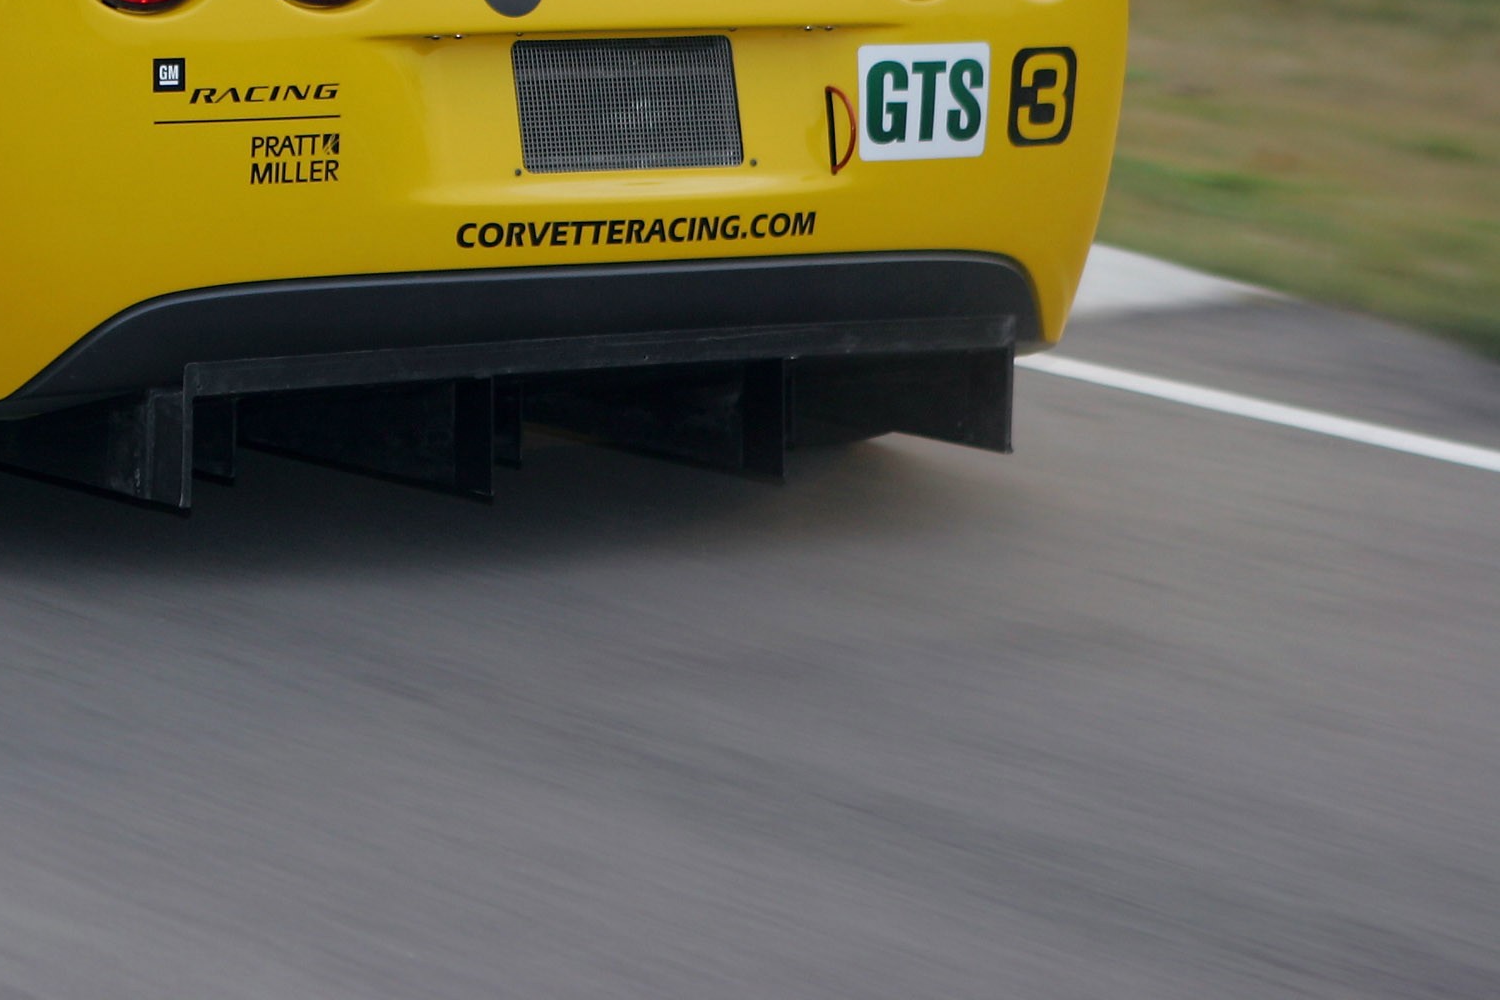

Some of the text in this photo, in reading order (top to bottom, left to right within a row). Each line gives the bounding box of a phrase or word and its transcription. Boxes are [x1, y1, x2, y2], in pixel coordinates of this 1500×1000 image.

[159, 64, 340, 104] GM RACING
[866, 58, 984, 144] GTS
[1013, 50, 1073, 143] 3
[251, 134, 320, 157] PRATT
[251, 160, 339, 184] MILLER
[456, 211, 816, 248] CORVETTERACING.COM
